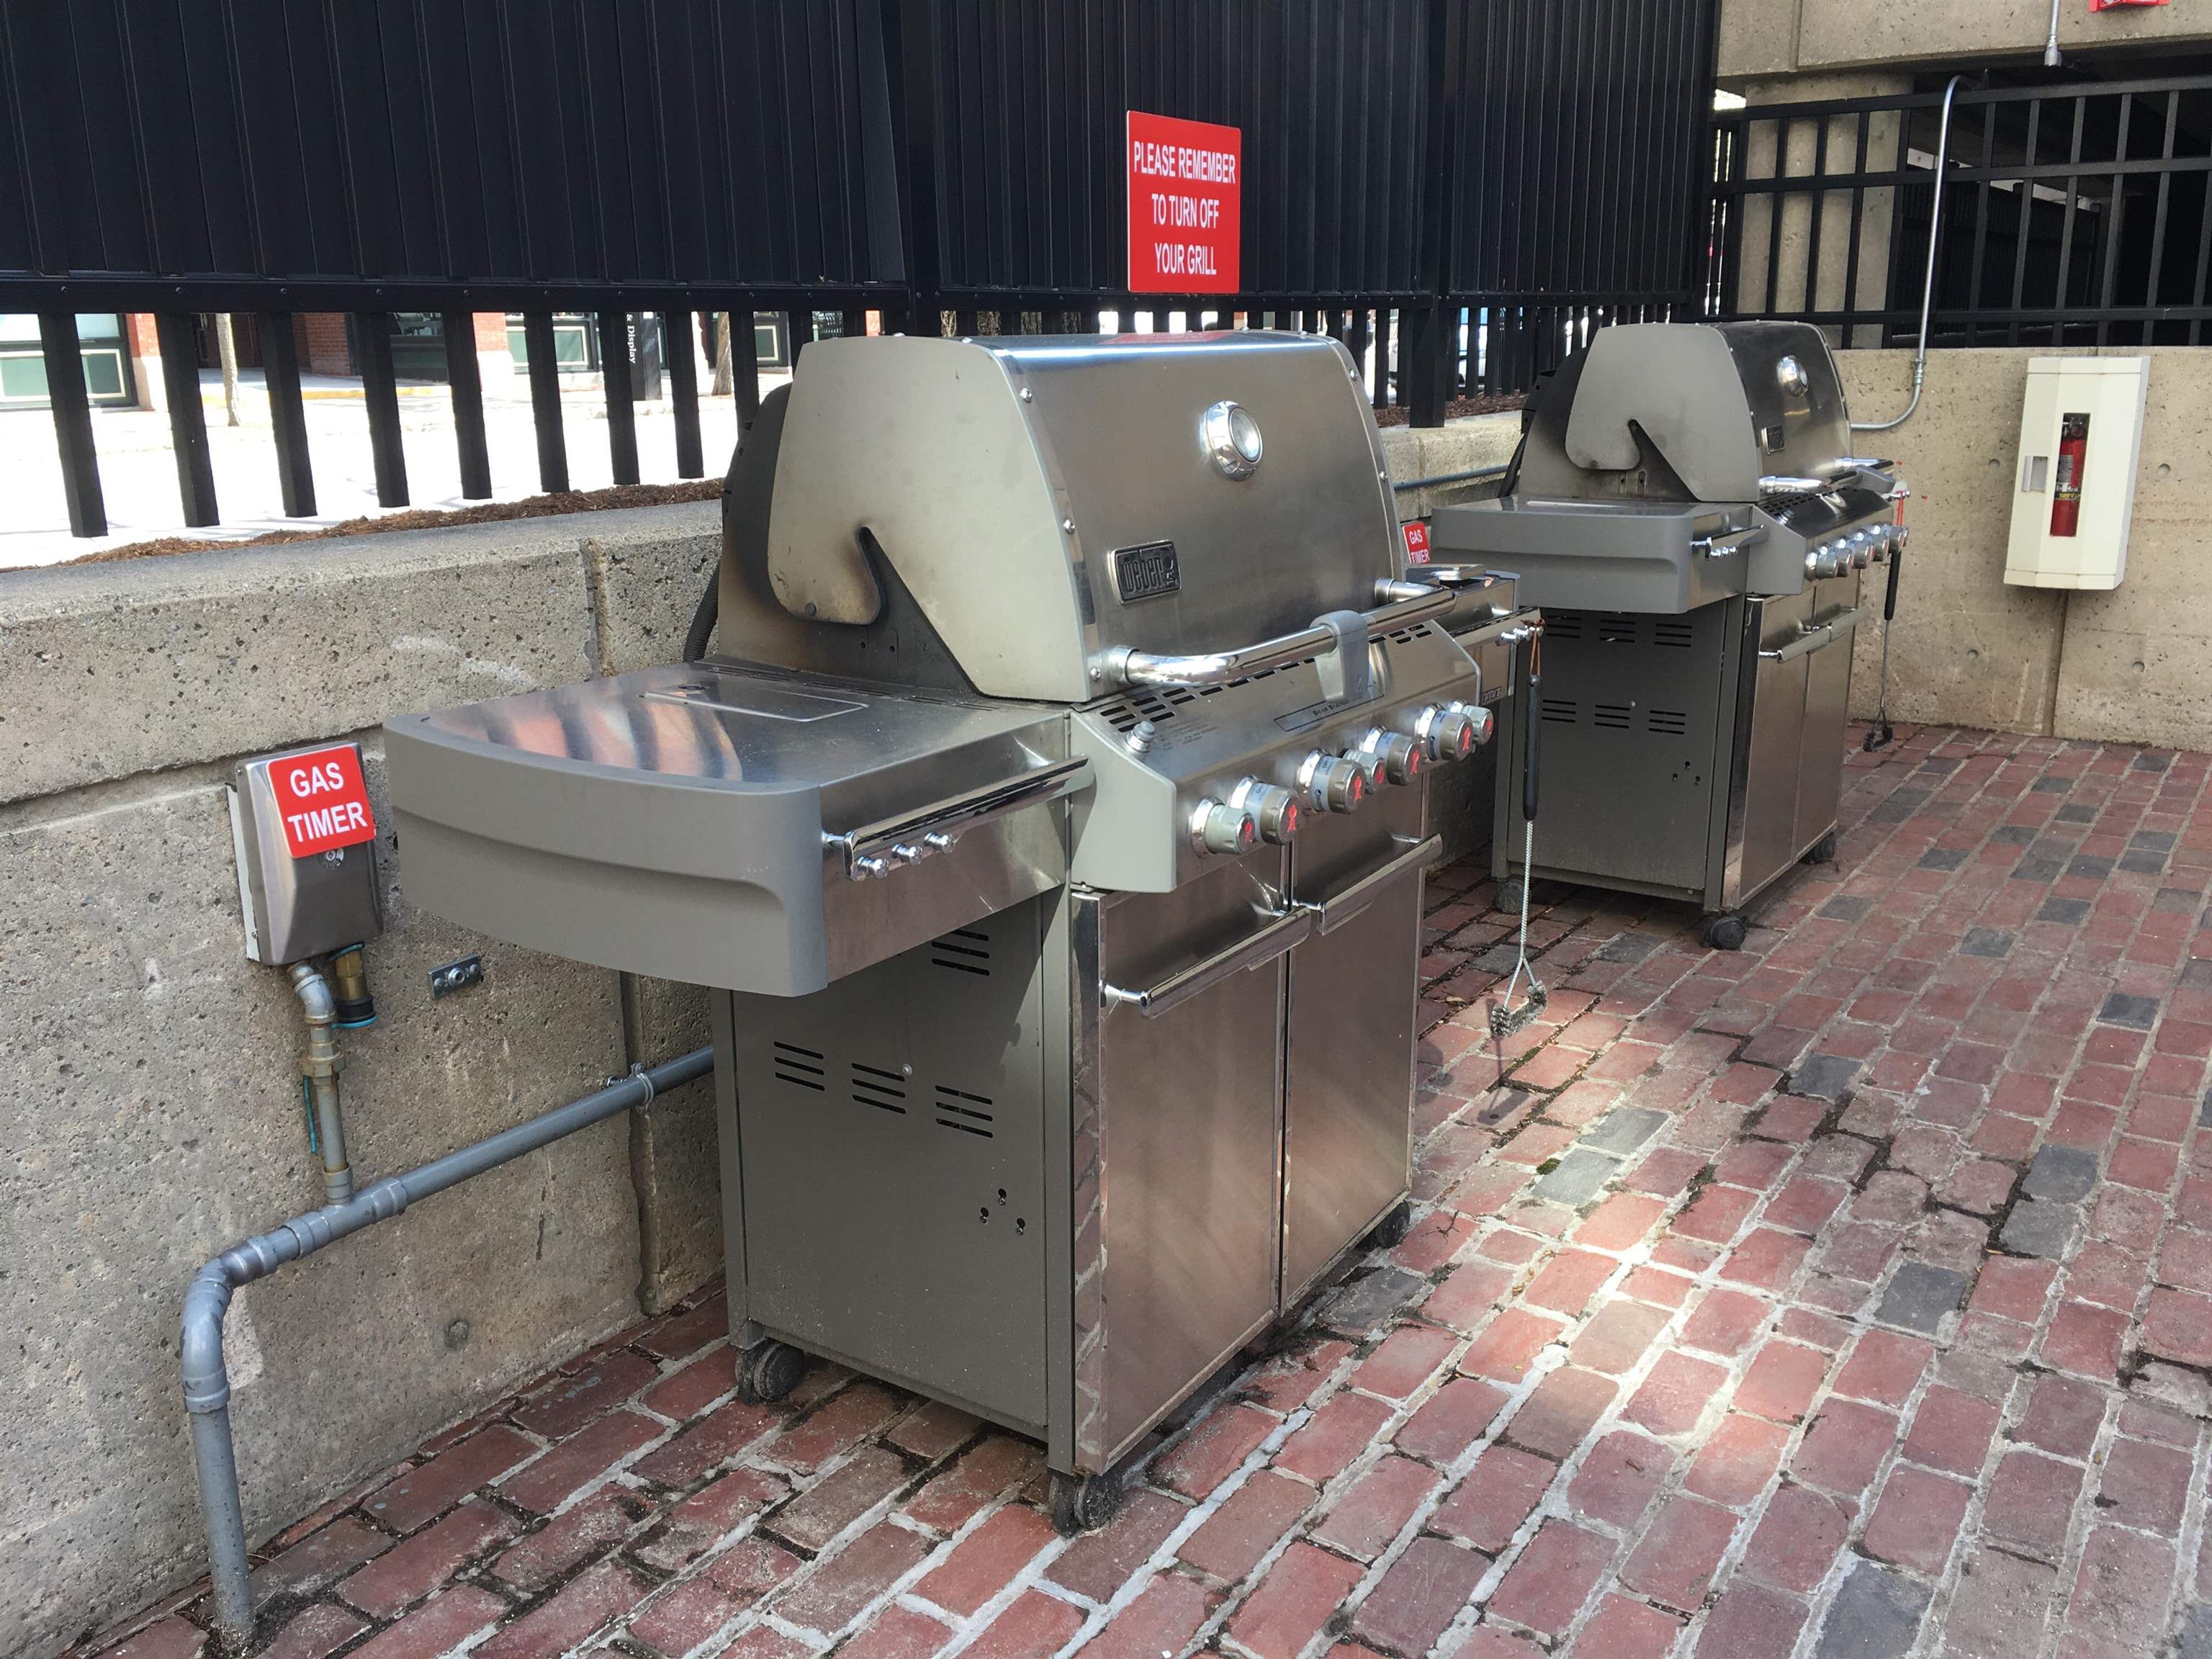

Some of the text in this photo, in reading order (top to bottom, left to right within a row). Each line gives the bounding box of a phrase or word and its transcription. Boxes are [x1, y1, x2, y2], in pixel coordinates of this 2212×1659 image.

[1134, 140, 1236, 184] PLEASE REMEMBER
[1151, 193, 1220, 229] TO TURN OFF
[1154, 242, 1217, 276] YOUR GRILL
[626, 313, 637, 364] & Display
[1409, 529, 1424, 544] GAS
[1411, 548, 1431, 565] TIMER
[289, 762, 344, 797] GAS
[287, 801, 367, 842] TIMER
